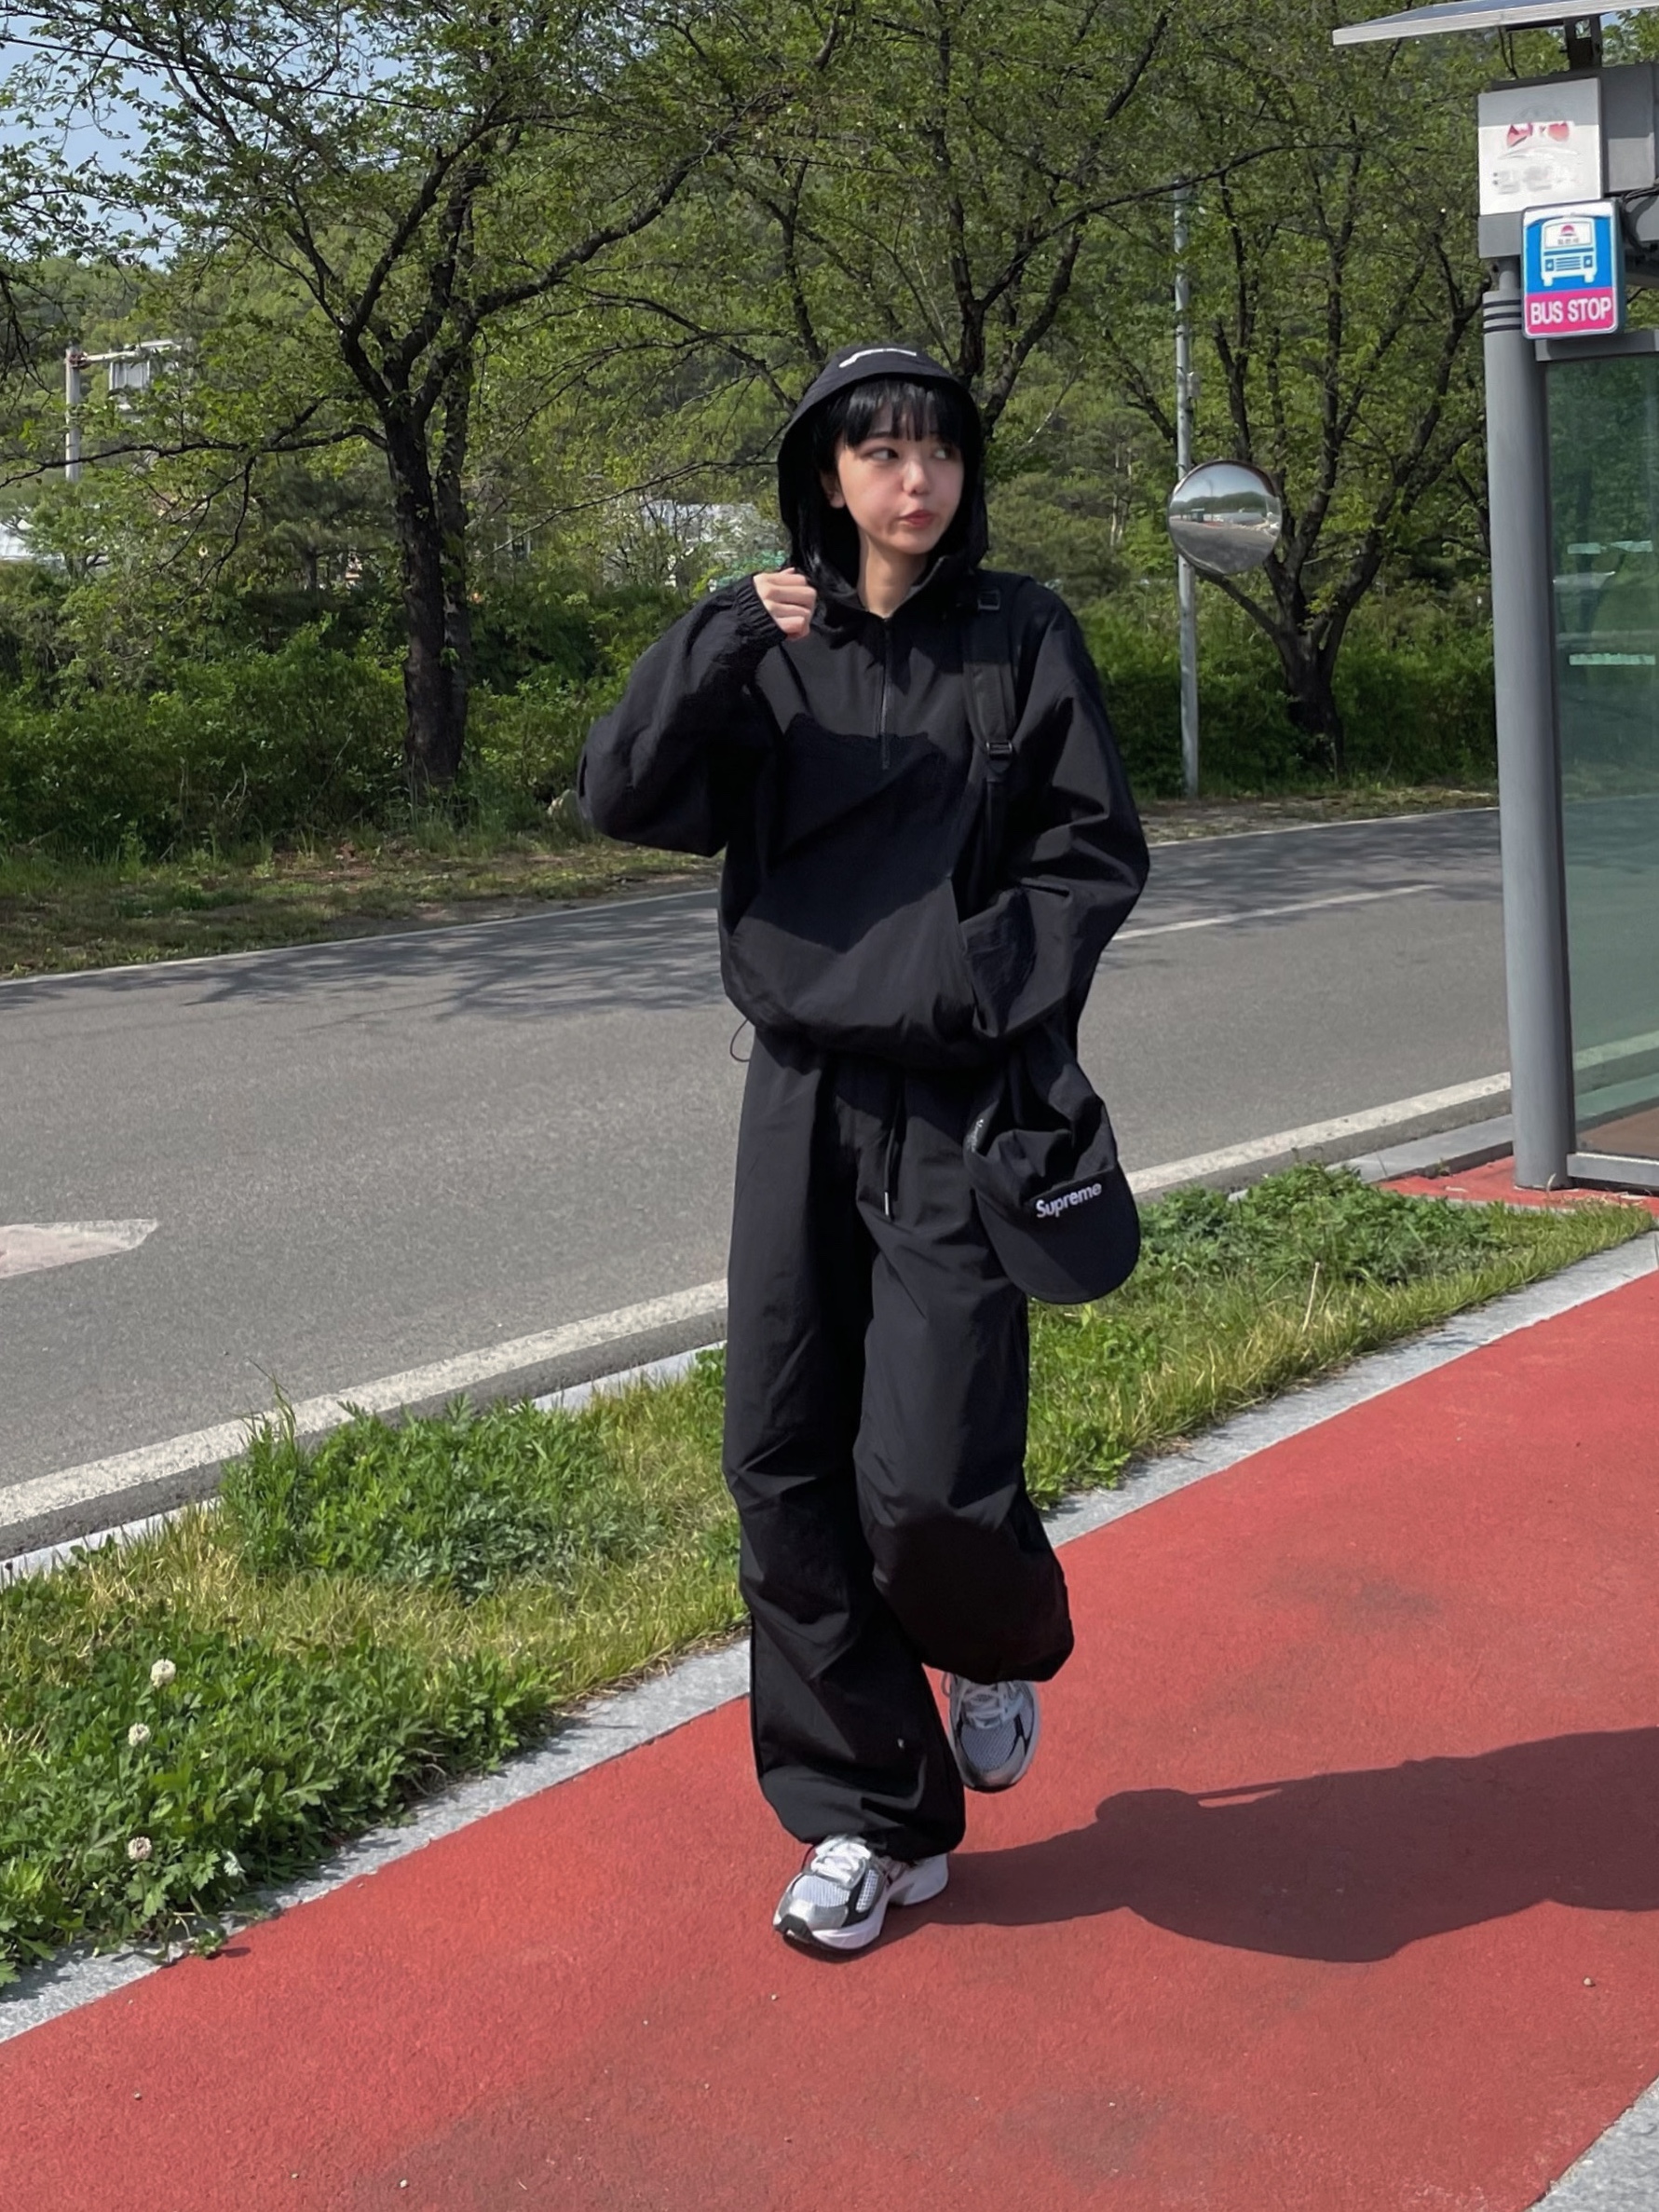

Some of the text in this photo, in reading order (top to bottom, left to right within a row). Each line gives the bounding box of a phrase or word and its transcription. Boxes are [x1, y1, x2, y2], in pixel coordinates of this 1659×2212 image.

[1530, 296, 1611, 325] BUS STOP
[1036, 1182, 1102, 1218] Supreme
